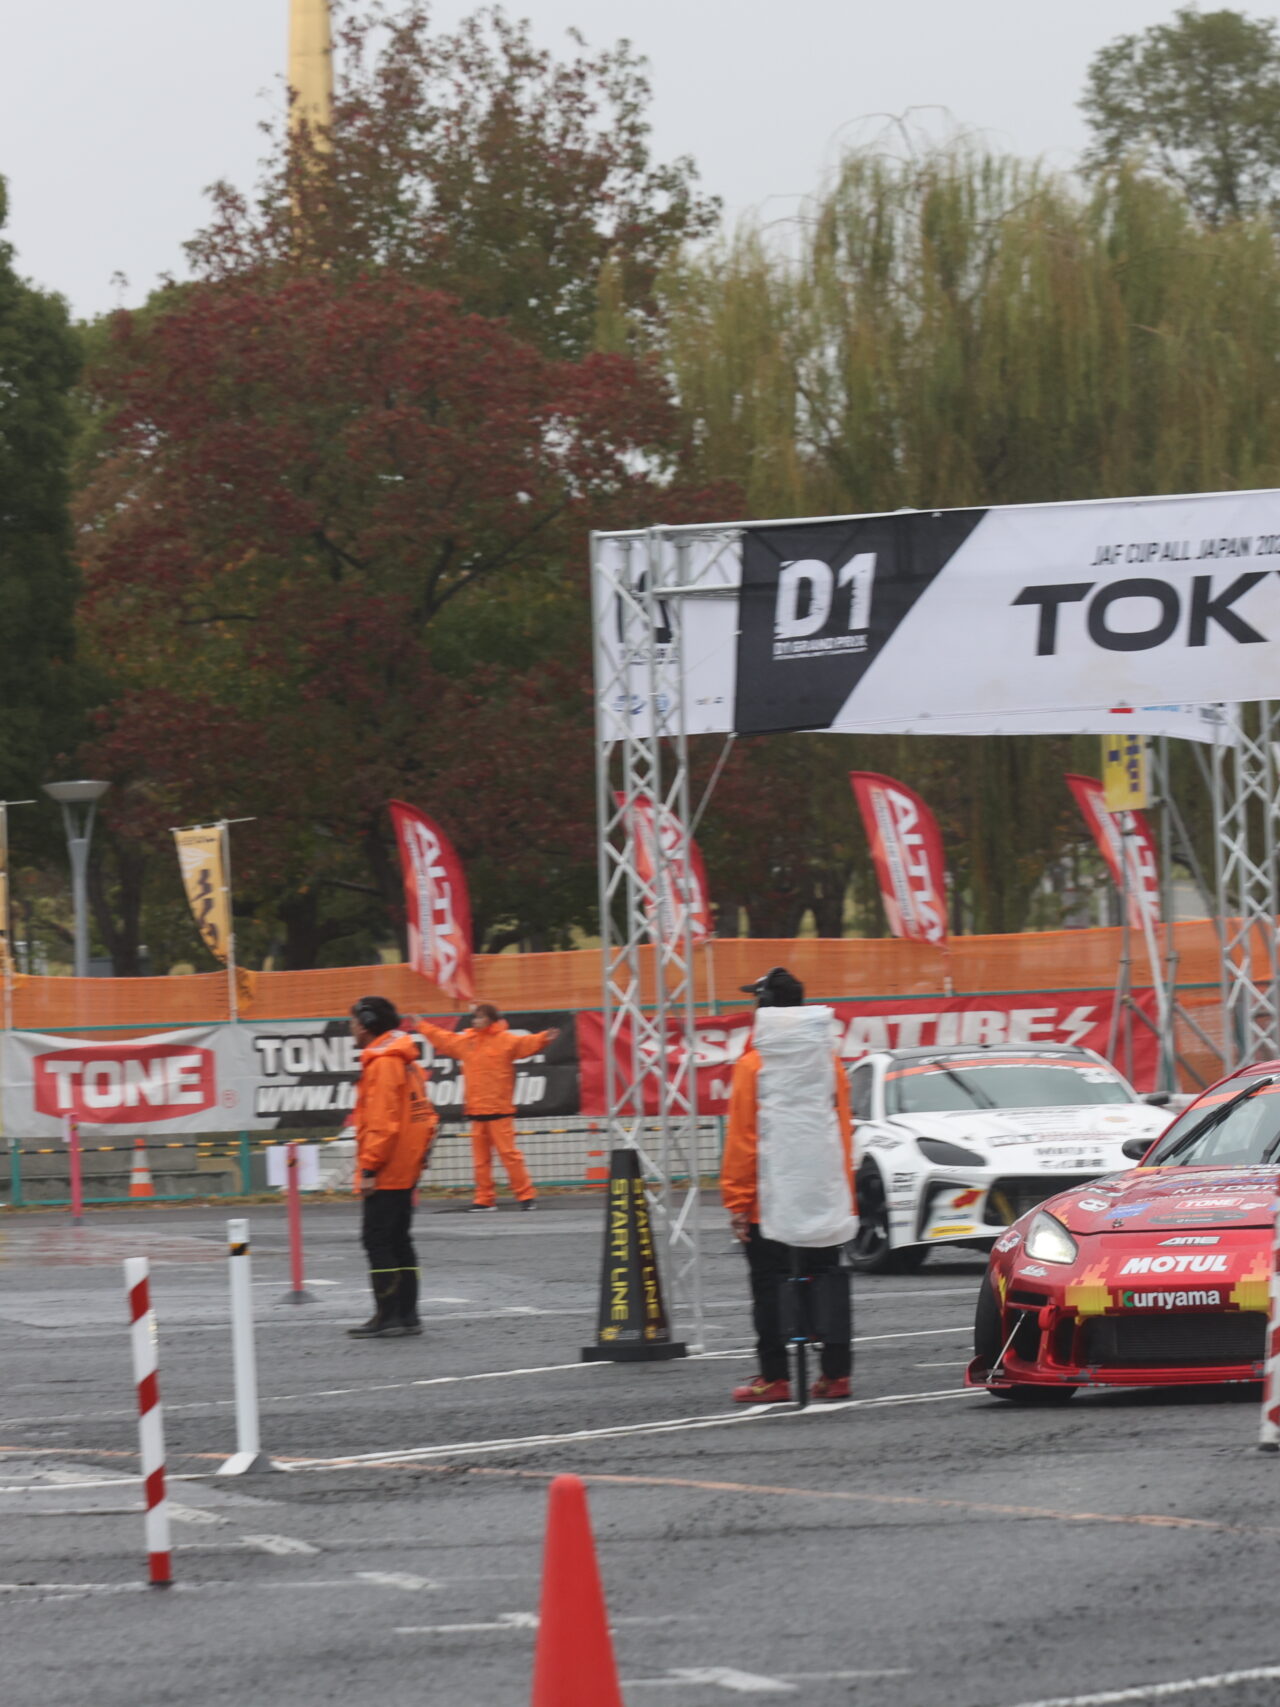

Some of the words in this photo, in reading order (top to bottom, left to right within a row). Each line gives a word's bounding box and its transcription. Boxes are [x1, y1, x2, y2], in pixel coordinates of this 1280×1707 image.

[1090, 543, 1124, 566] JAF
[1125, 542, 1158, 564] CUP
[1158, 540, 1190, 562] ALL
[1196, 536, 1252, 560] JAPAN
[773, 552, 878, 640] D1
[44, 1053, 204, 1110] TONE
[611, 1177, 630, 1262] START
[1185, 1198, 1235, 1208] TONE
[1119, 1255, 1229, 1275] MOTUL
[611, 1267, 630, 1321] LINE
